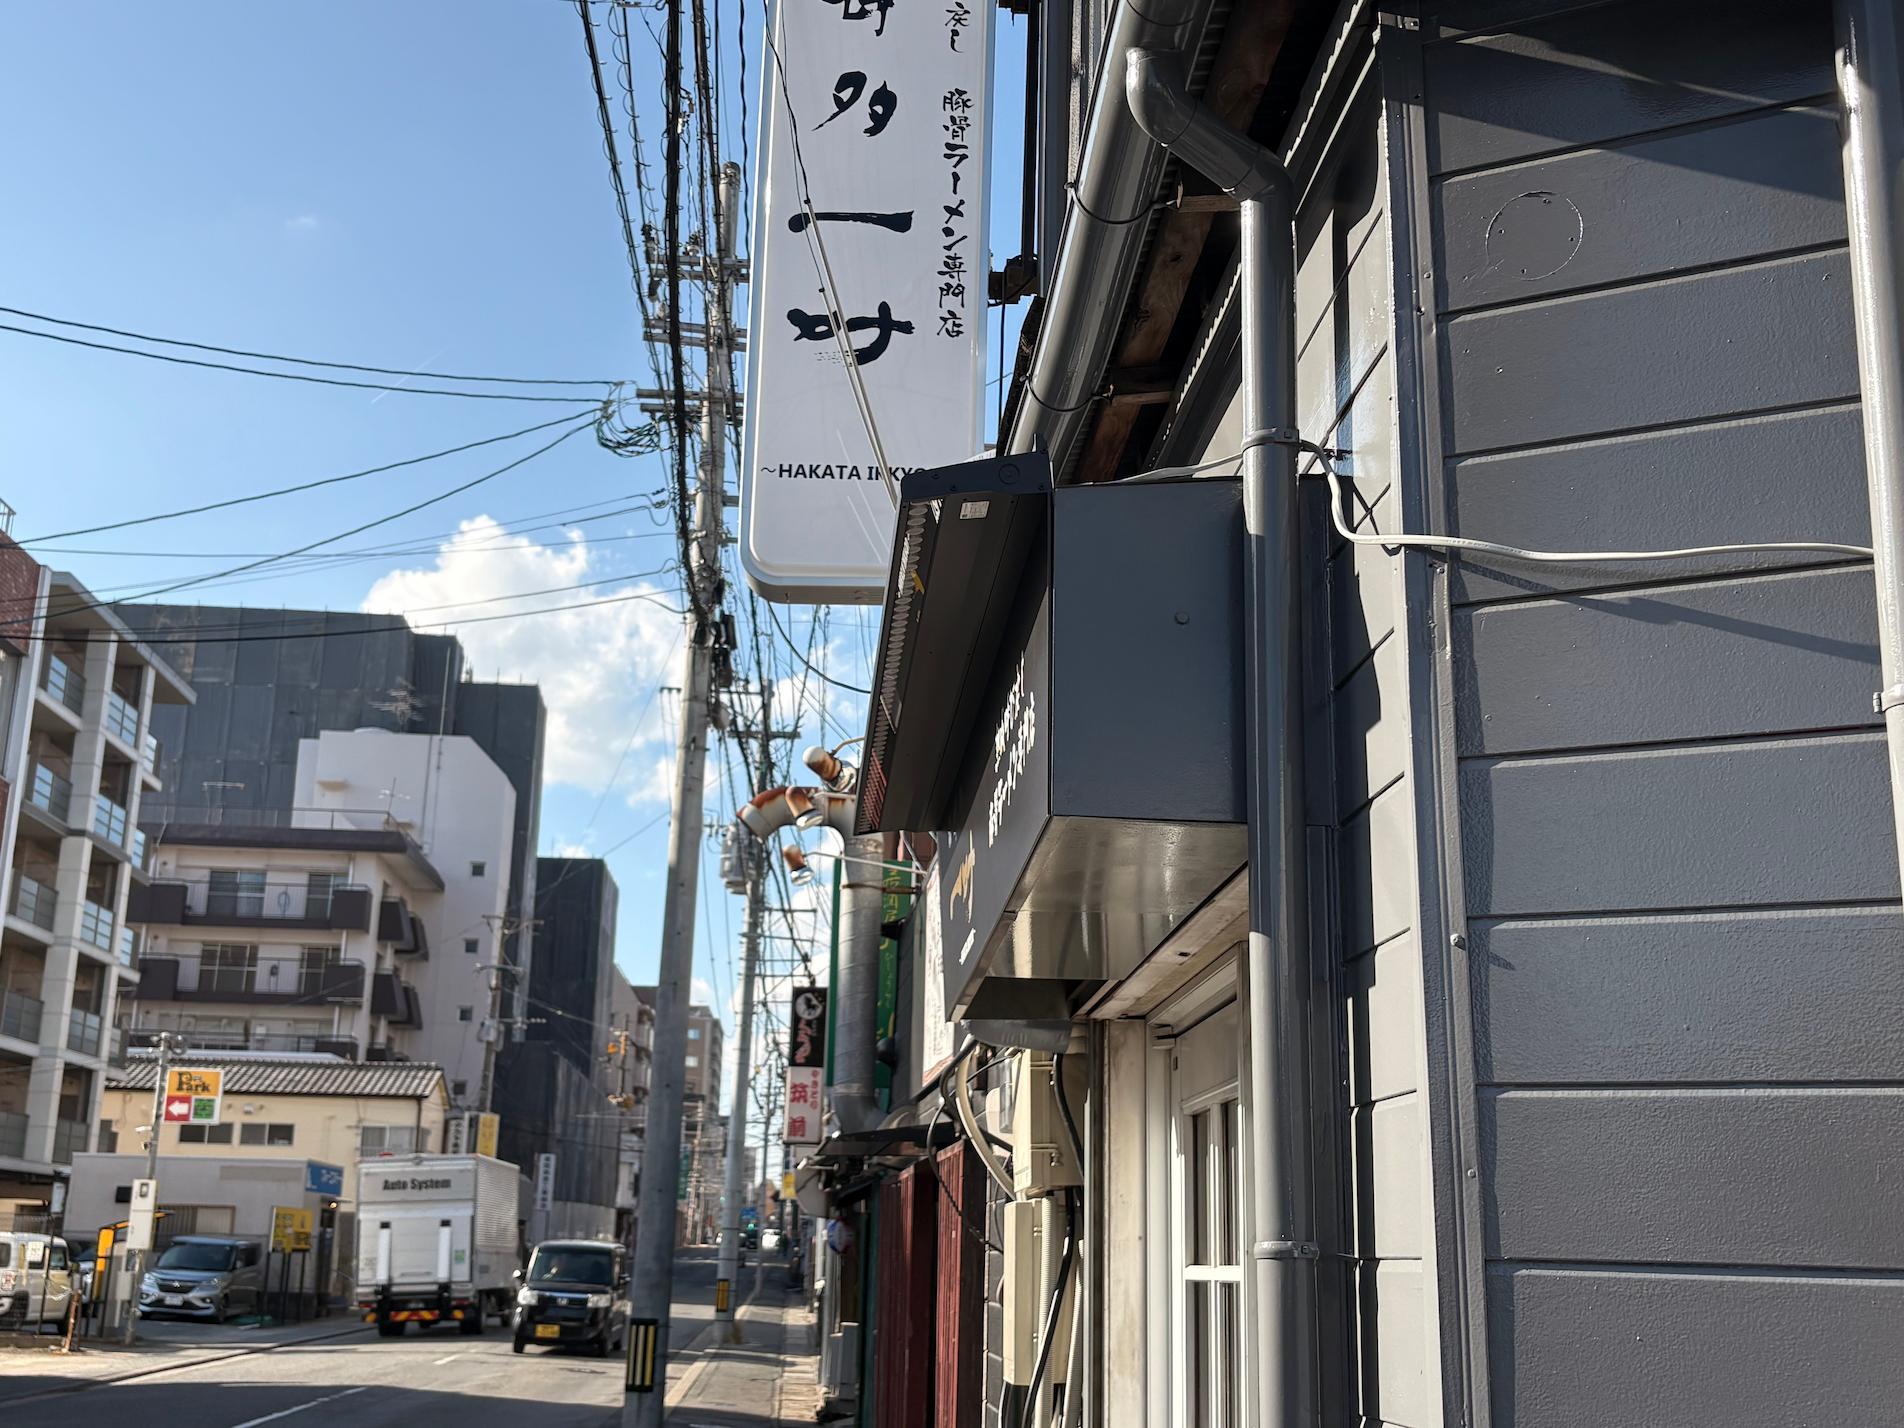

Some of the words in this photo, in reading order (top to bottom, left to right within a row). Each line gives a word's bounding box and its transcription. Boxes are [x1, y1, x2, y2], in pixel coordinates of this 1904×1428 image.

[937, 88, 975, 338] 豚骨ラーメン専門店
[382, 1179, 408, 1191] Auto
[410, 1177, 452, 1192] System
